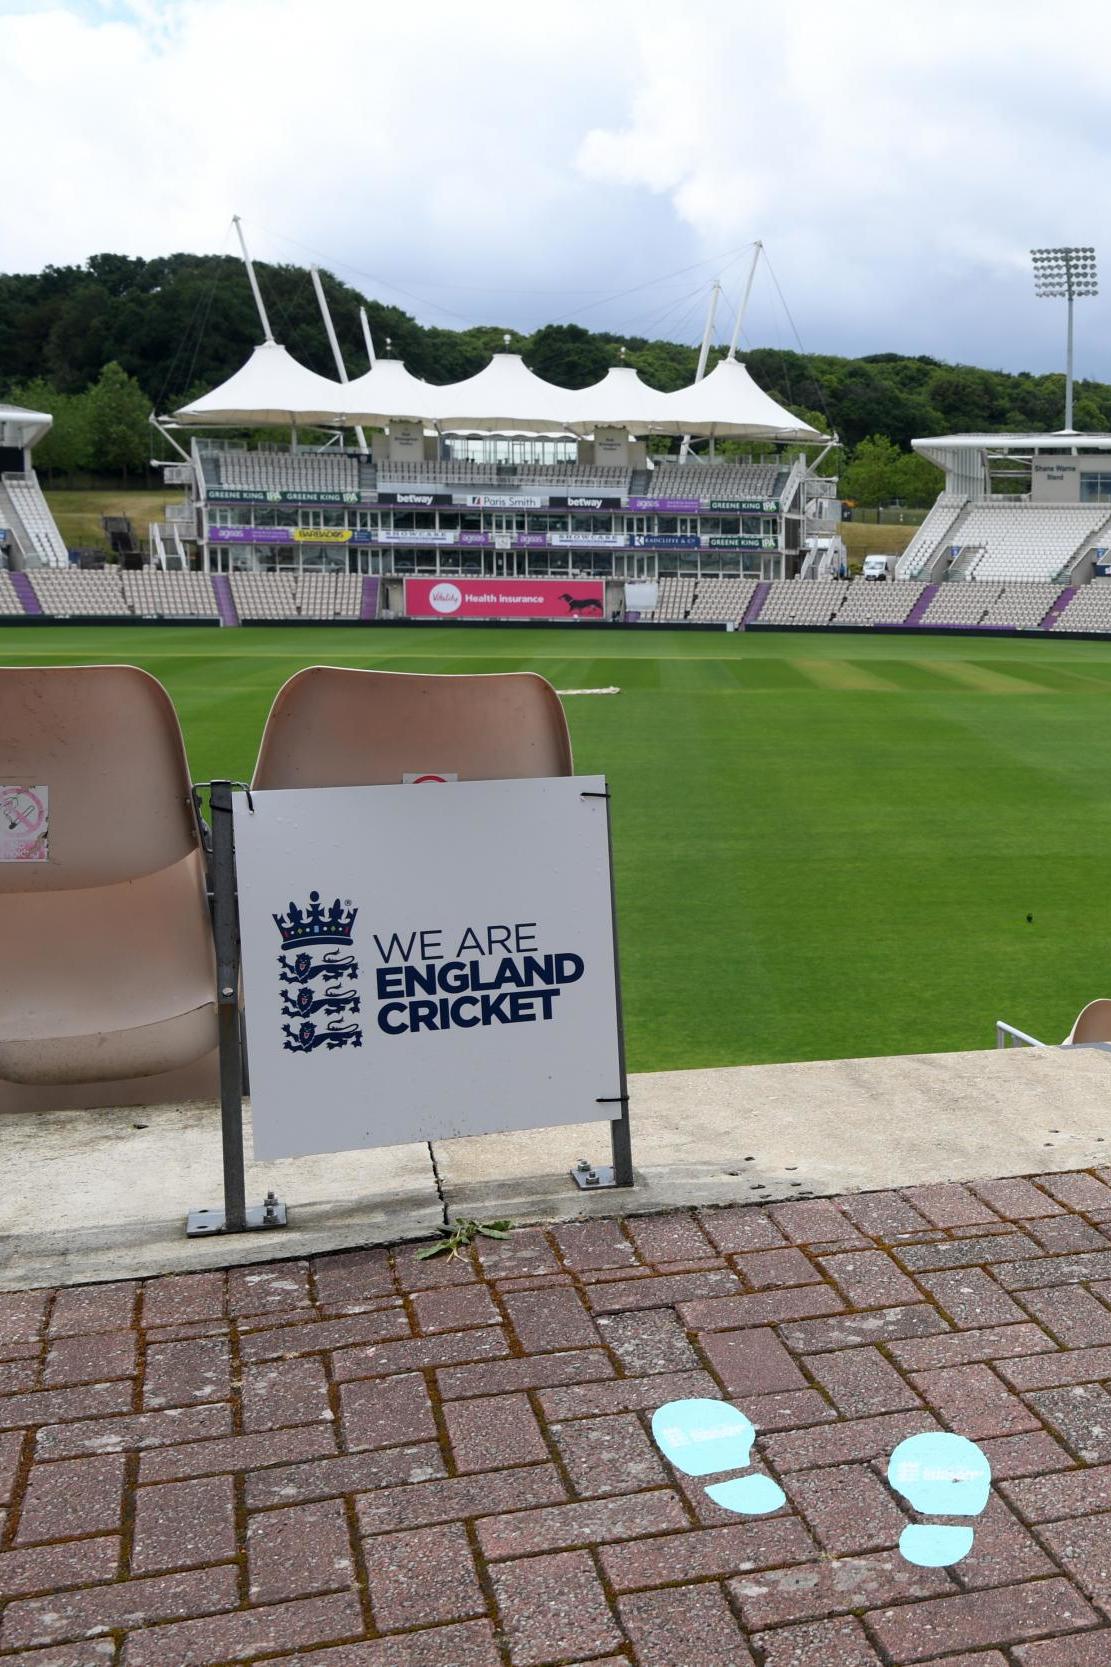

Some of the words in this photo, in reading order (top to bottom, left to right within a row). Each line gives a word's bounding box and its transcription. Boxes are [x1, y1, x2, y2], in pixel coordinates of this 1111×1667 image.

[209, 491, 240, 499] GREENE
[243, 491, 264, 499] KING
[286, 493, 318, 501] GREENE
[320, 493, 341, 501] KING
[396, 493, 433, 505] betway
[484, 496, 506, 506] Paris
[509, 496, 536, 507] Smith
[567, 497, 602, 509] betway
[711, 502, 740, 510] GREENE
[742, 502, 761, 510] KING
[711, 539, 739, 547] GREENE
[741, 539, 760, 547] KING
[465, 593, 497, 603] Health
[372, 929, 444, 964] WE
[456, 922, 539, 958] ARE
[376, 952, 585, 1000] ENGLAND
[377, 988, 561, 1035] CRICKET
